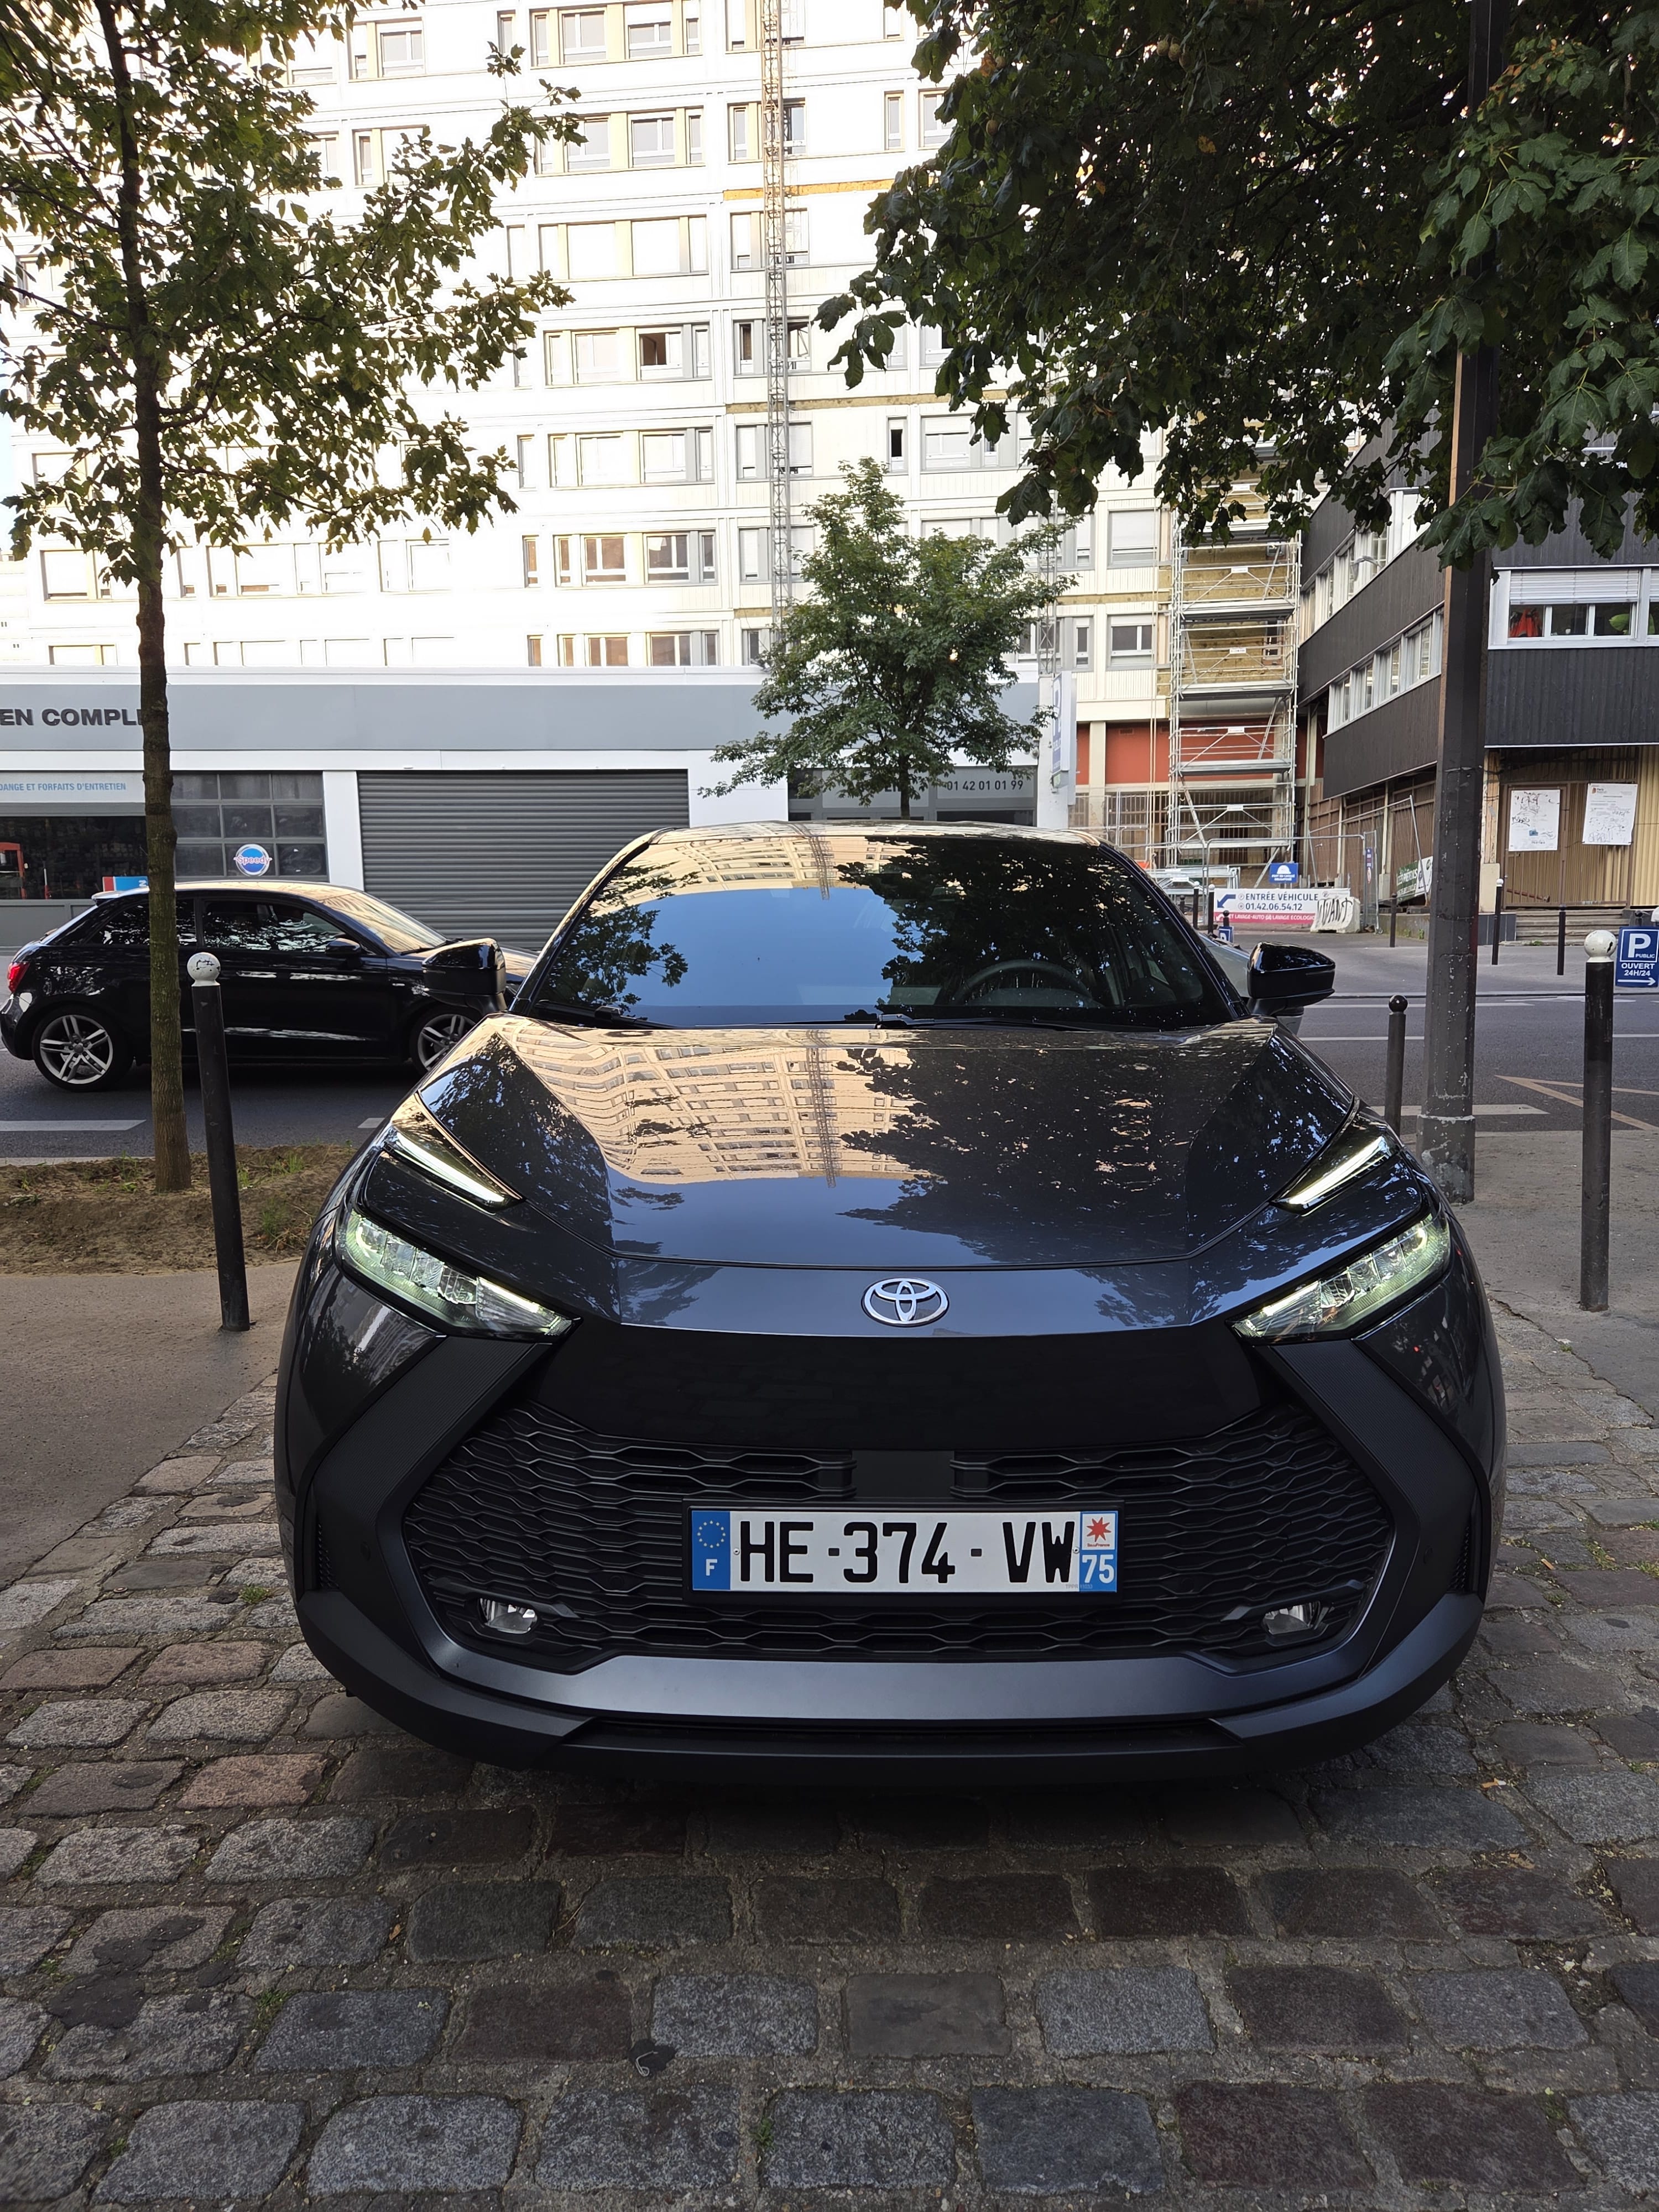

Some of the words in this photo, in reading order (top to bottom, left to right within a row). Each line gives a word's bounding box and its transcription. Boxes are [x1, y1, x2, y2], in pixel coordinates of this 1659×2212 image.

[77, 782, 126, 791] D'ENTRETIEN
[947, 780, 958, 791] 01
[963, 780, 975, 791] 42
[979, 780, 990, 790] 01
[995, 780, 1006, 790] 01
[1011, 780, 1023, 790] 99
[234, 855, 272, 865] Speedy
[1245, 891, 1275, 901] ENTRÉE
[1277, 891, 1318, 901] VÉHICULE
[1245, 902, 1302, 911] 01.42.06.54.12
[1627, 933, 1651, 958] P
[705, 1559, 716, 1576] F
[1082, 1554, 1114, 1584] 75
